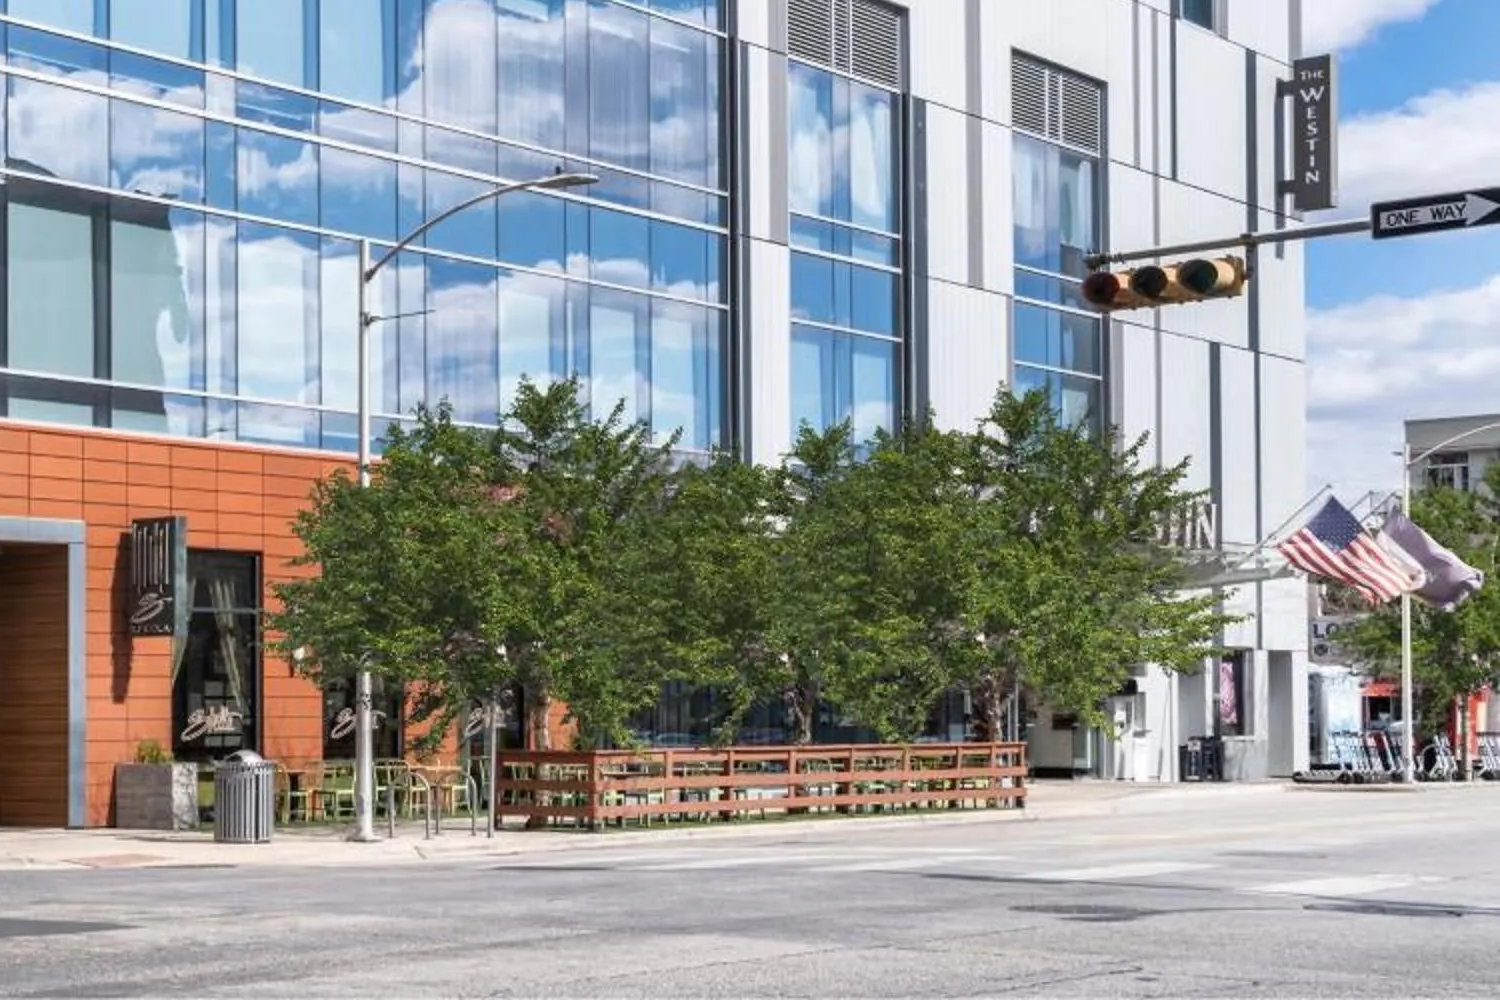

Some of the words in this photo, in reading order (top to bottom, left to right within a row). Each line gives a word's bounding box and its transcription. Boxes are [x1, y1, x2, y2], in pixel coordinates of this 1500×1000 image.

[1300, 69, 1325, 81] THE
[1300, 85, 1325, 184] WESTIN
[1386, 209, 1421, 227] ONE
[1429, 203, 1467, 221] WAY
